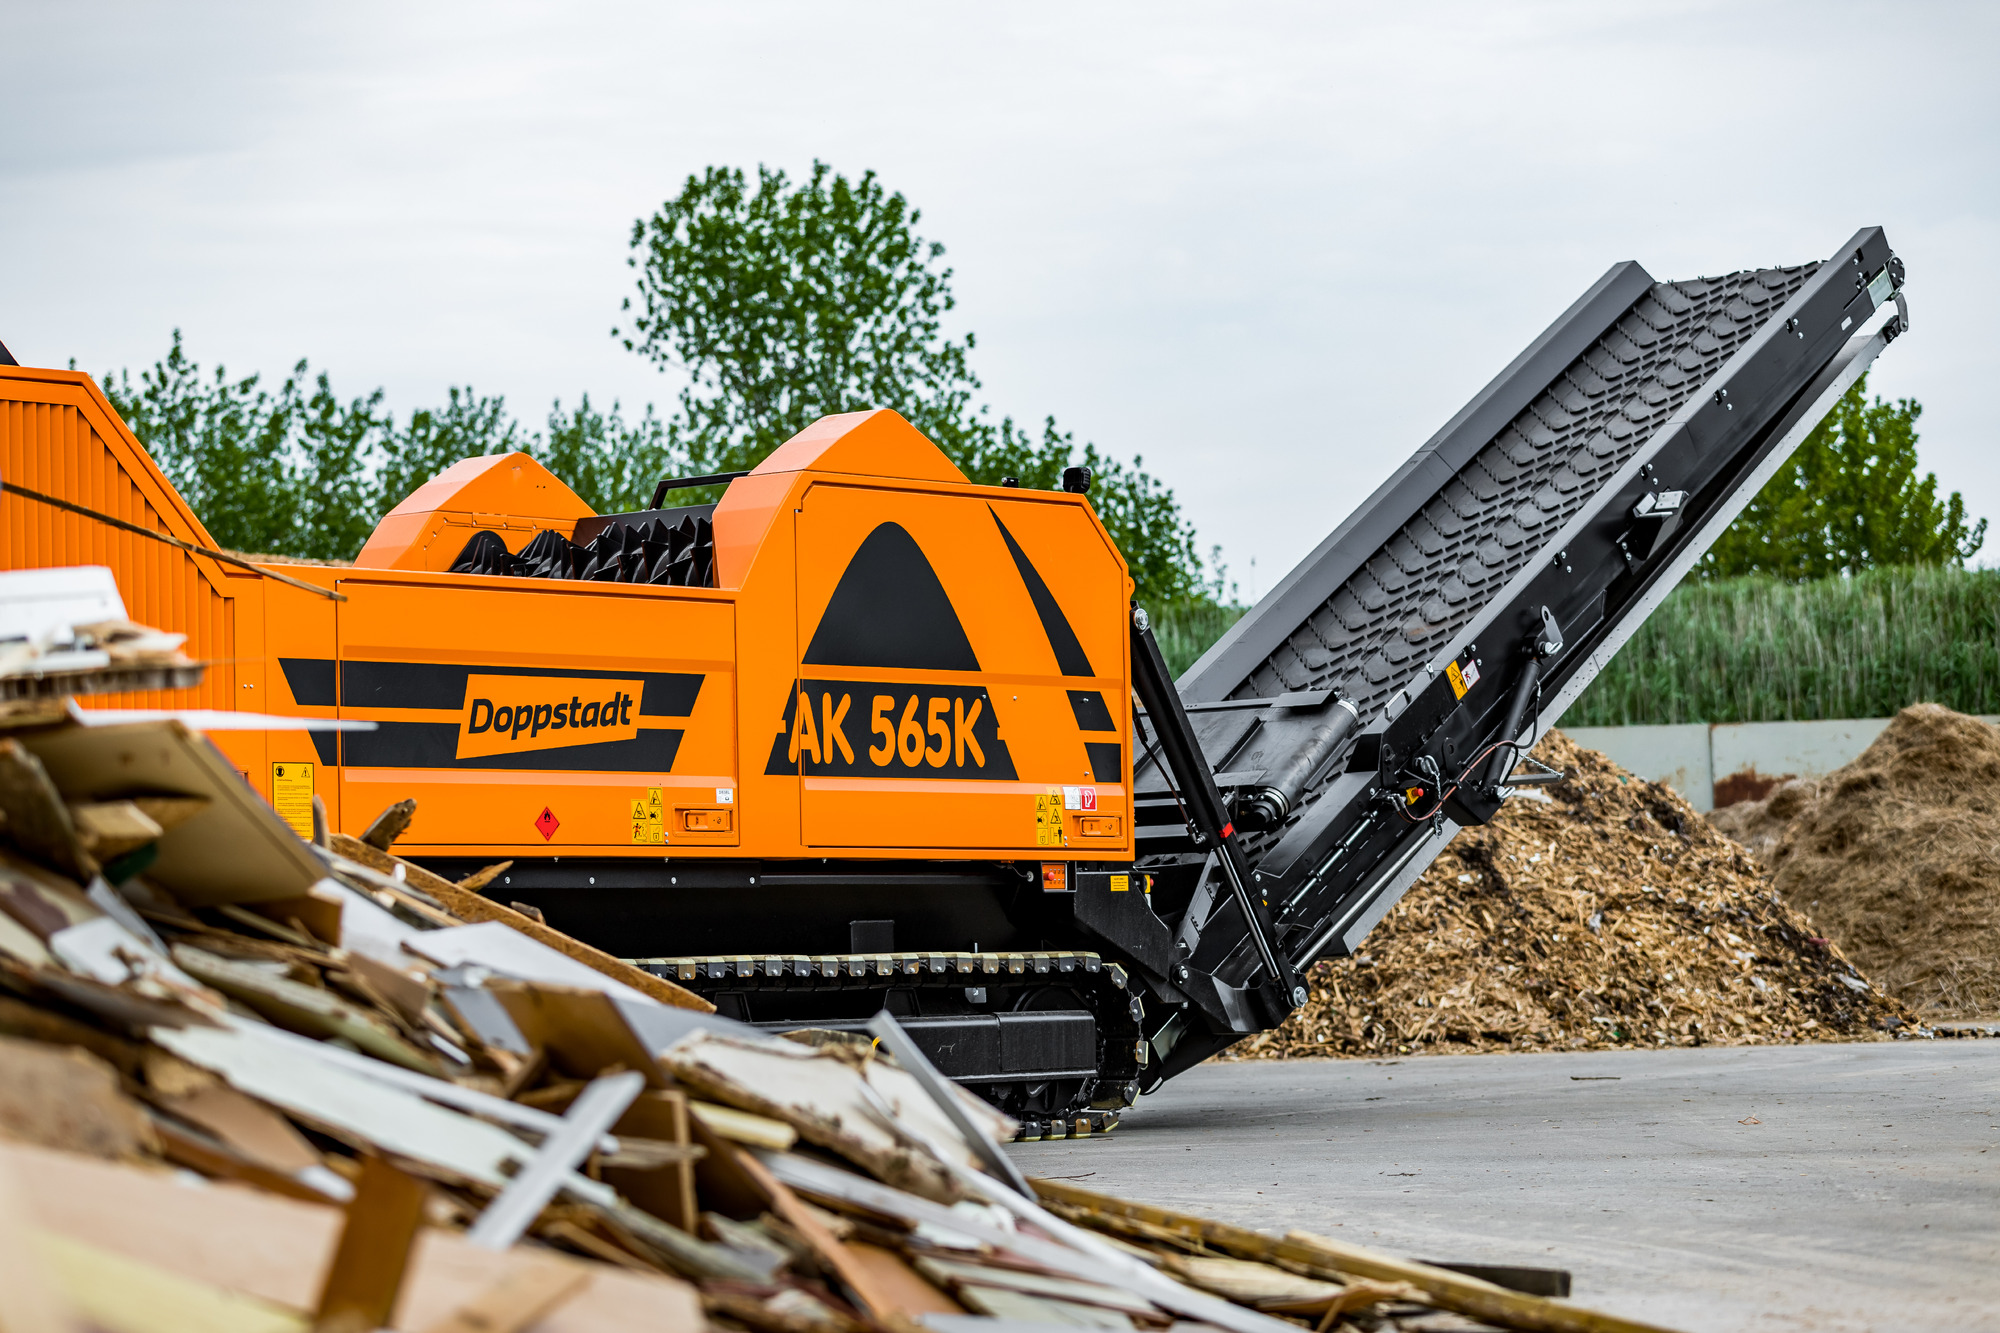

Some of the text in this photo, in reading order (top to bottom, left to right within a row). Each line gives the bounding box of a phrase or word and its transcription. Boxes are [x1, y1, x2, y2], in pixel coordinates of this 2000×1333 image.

[468, 691, 633, 740] Doppstadt
[788, 691, 986, 768] AK 565K
